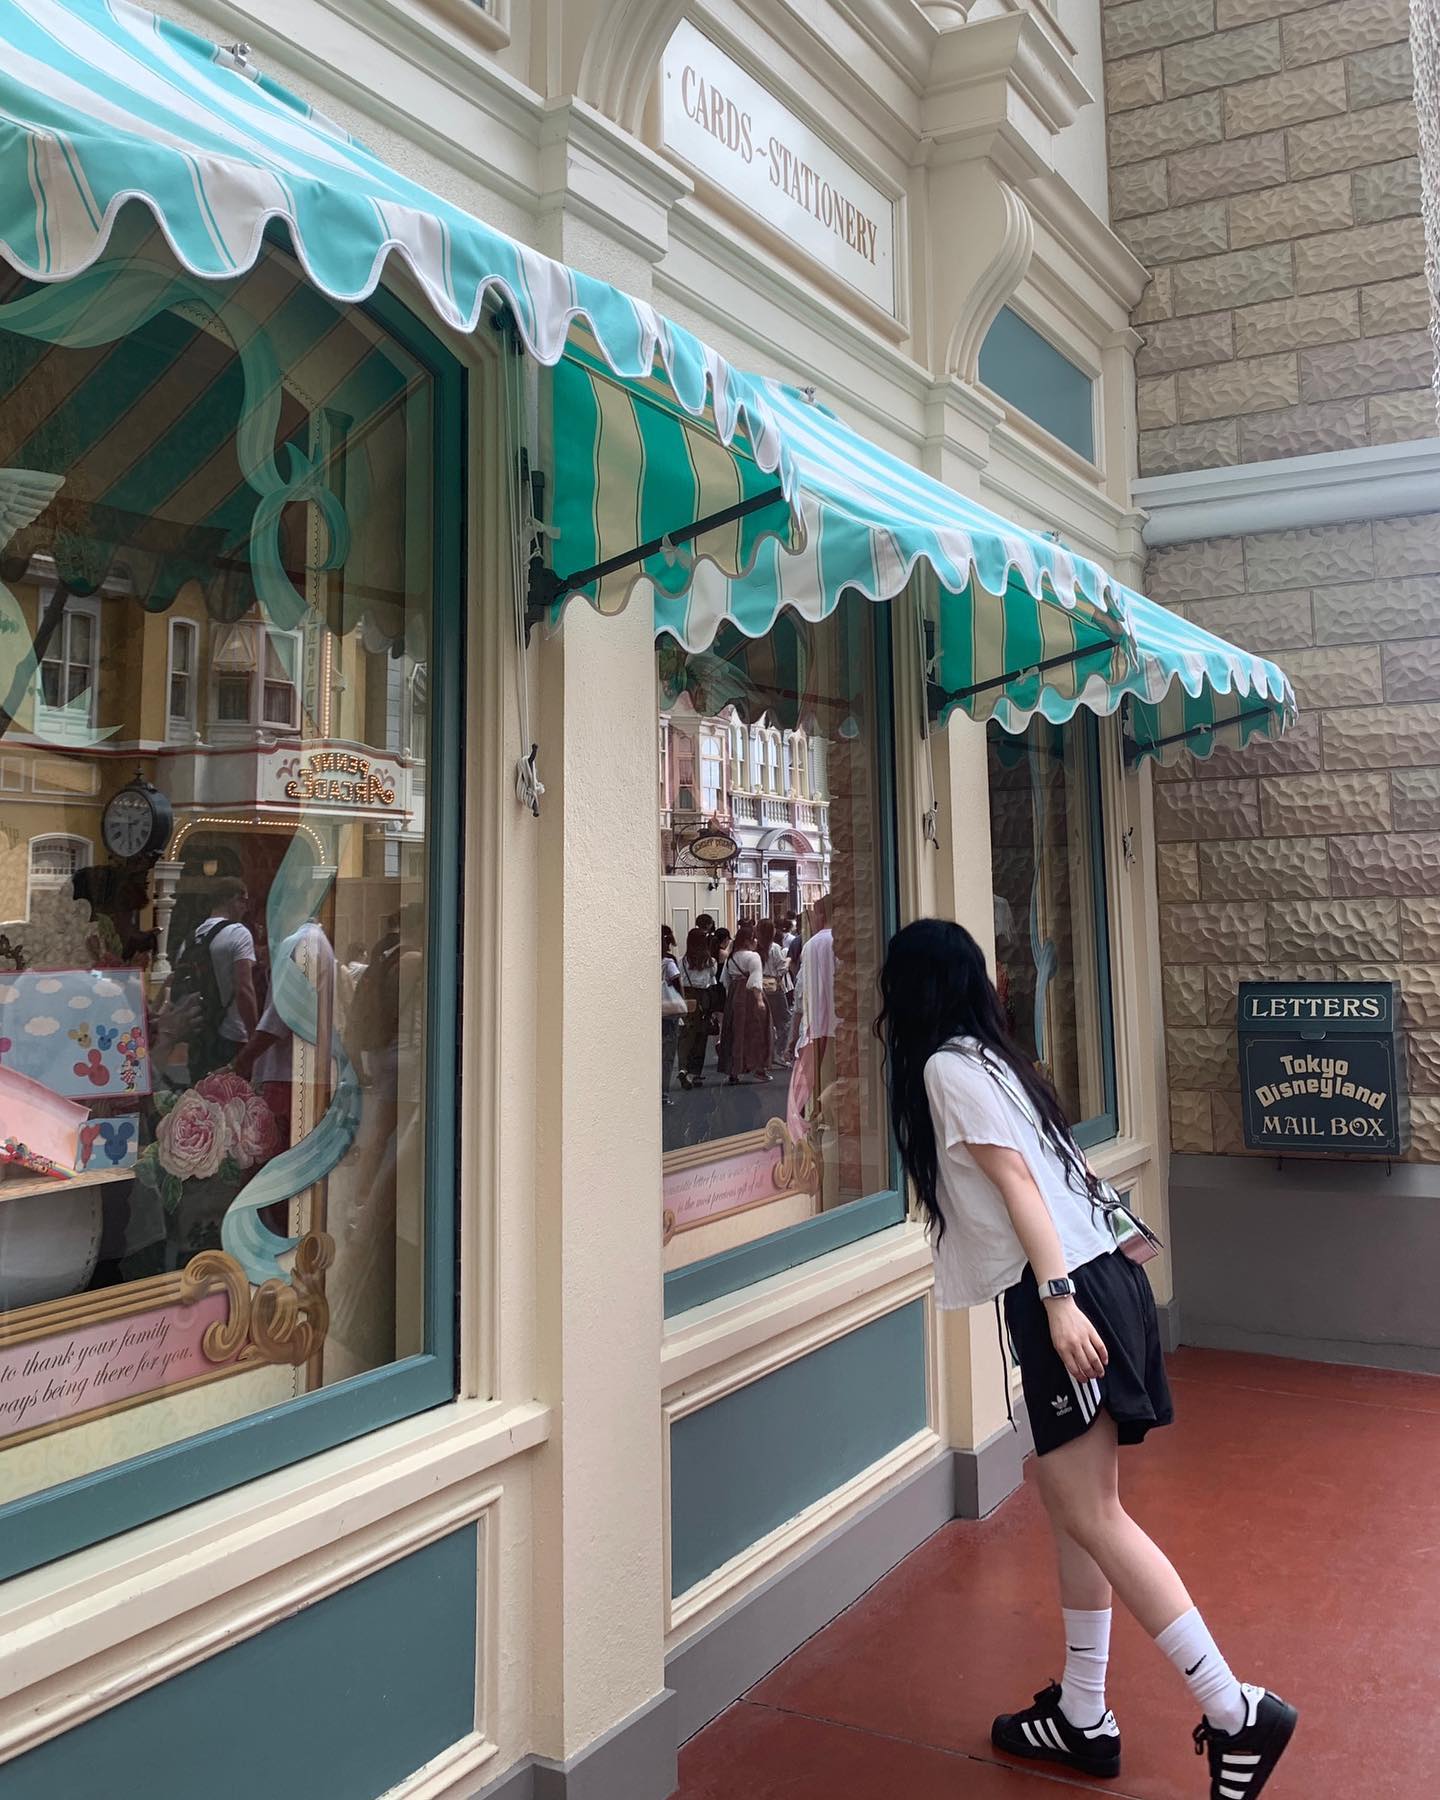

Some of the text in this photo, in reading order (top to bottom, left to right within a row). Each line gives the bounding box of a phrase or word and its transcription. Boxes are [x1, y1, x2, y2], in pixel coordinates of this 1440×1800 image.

[681, 65, 752, 164] CARDS
[768, 136, 877, 265] STATIONERY
[1251, 998, 1380, 1017] LETTERS
[1279, 1054, 1349, 1078] Tokyo
[1255, 1076, 1387, 1111] Disneyland
[1262, 1115, 1385, 1137] MAIL BOX
[0, 1316, 170, 1384] to thank your family
[42, 1378, 89, 1405] being
[93, 1362, 134, 1388] there
[131, 1351, 160, 1384] for
